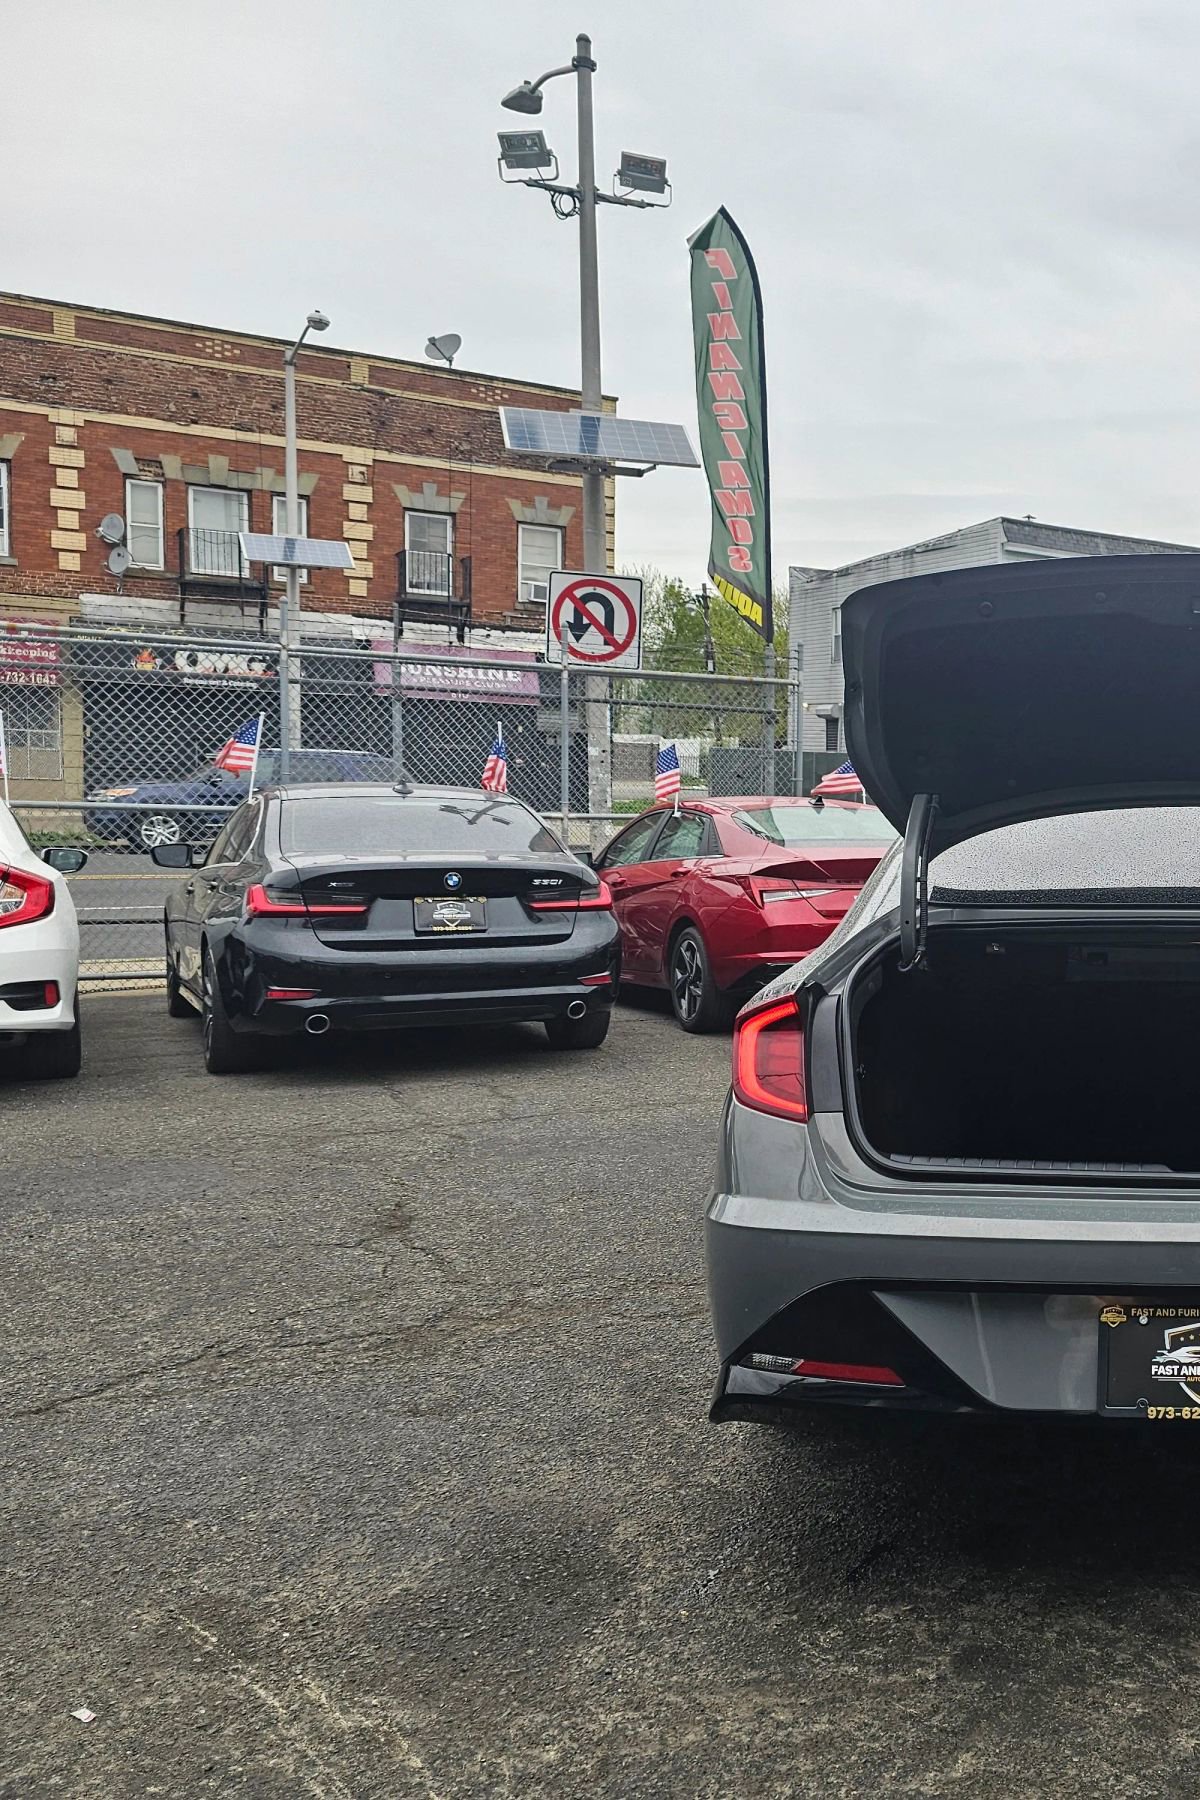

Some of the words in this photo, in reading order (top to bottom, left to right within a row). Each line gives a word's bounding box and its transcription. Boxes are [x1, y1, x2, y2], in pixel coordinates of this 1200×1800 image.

[1131, 1307, 1154, 1317] FAST
[1155, 1308, 1176, 1317] AND
[1151, 1365, 1180, 1376] FAST
